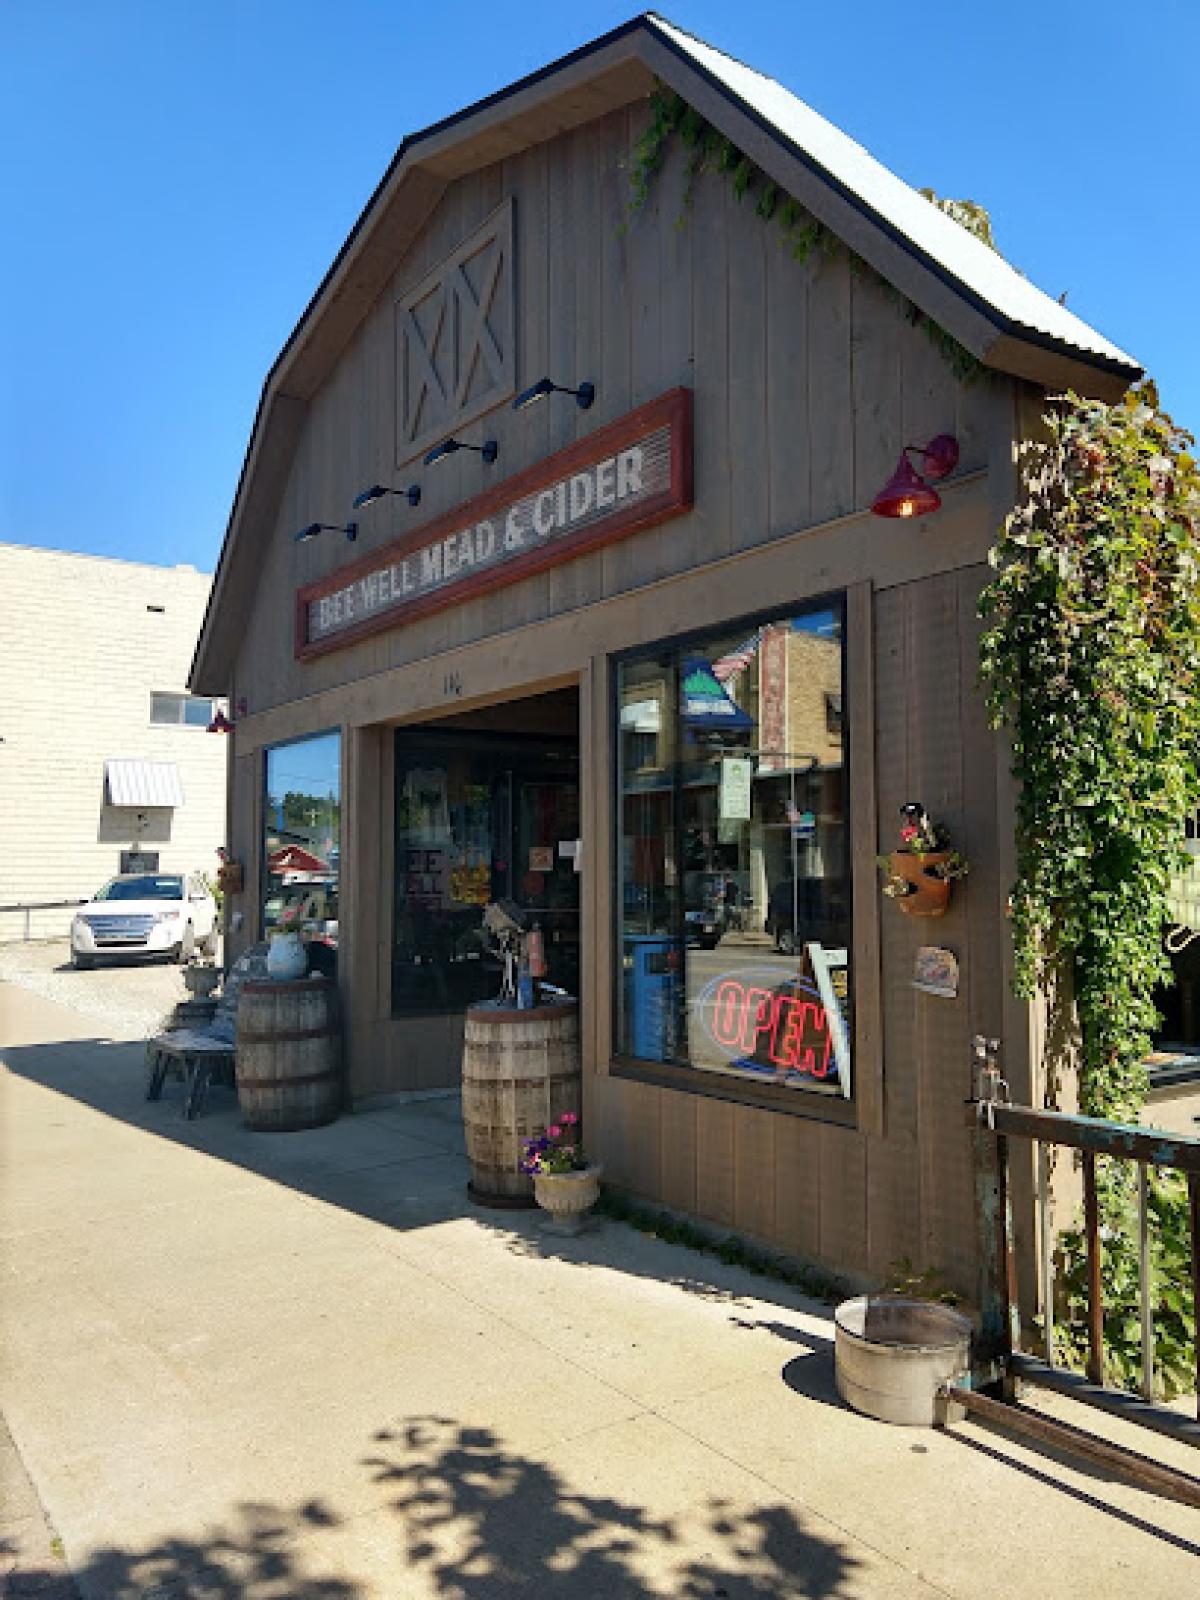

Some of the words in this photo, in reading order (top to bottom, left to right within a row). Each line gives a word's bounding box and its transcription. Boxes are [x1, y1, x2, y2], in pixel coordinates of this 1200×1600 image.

[320, 584, 354, 630] BEE
[358, 561, 416, 609] WELL
[419, 520, 495, 586] MEAD
[502, 505, 525, 550] &
[534, 446, 643, 535] CIDER
[711, 980, 833, 1078] OPEN
